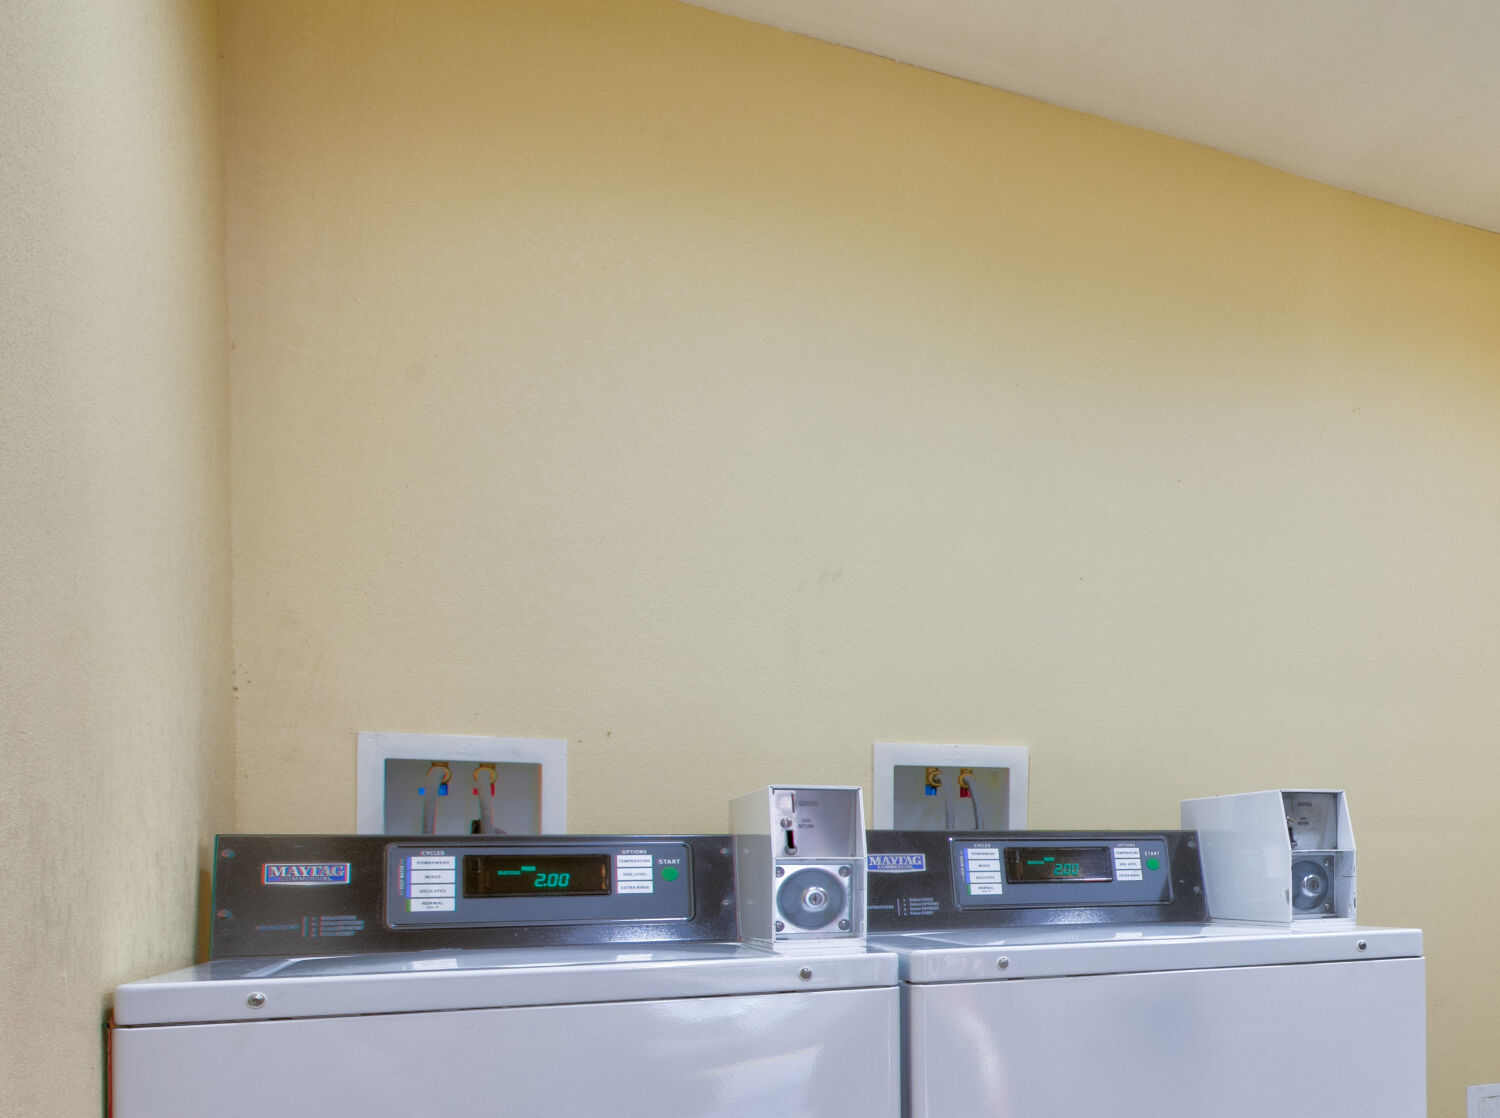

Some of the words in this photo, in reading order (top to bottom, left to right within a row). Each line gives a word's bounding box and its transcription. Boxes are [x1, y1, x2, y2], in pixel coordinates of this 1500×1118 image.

[869, 855, 922, 865] MAYTAG
[270, 865, 345, 877] MAYTAG
[534, 873, 570, 888] 2.00
